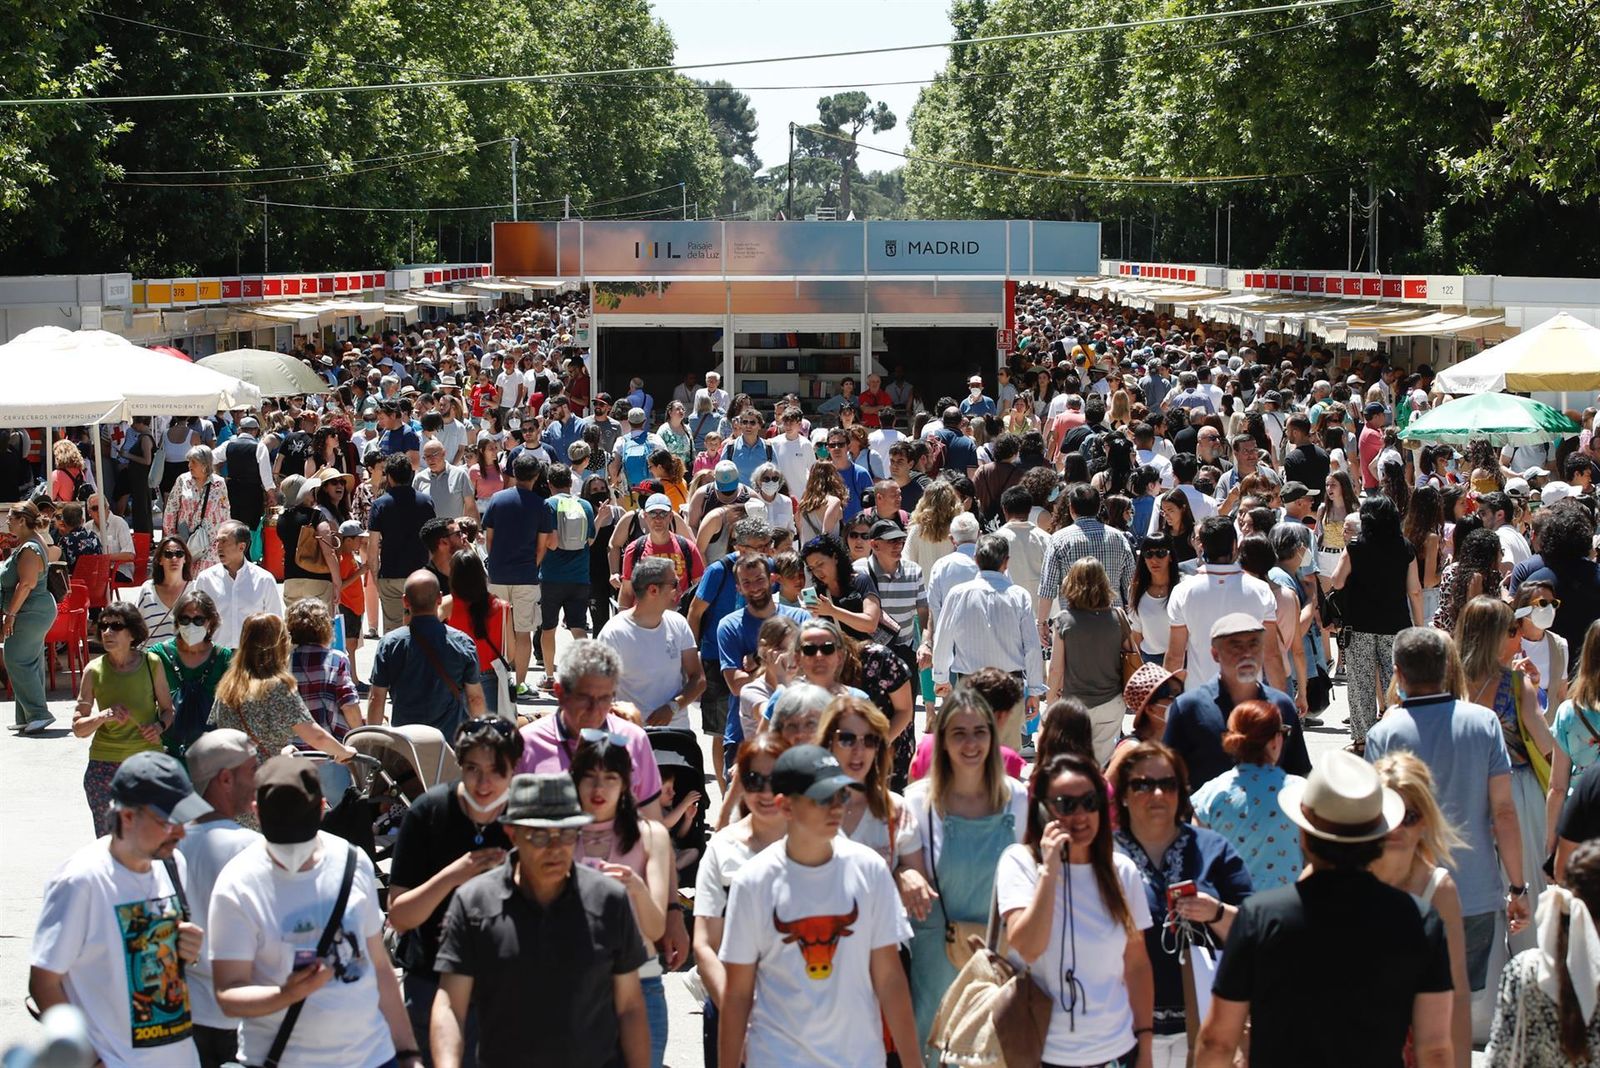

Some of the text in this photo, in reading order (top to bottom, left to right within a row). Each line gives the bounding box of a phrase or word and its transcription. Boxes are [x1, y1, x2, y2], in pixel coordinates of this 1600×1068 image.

[687, 242, 712, 253] Paisaje
[908, 241, 980, 255] MADRID
[687, 251, 697, 259] de
[706, 250, 719, 259] Luz
[222, 285, 230, 293] 76
[243, 284, 251, 293] 75
[1393, 283, 1401, 291] 12
[1416, 285, 1427, 293] 123
[1442, 286, 1453, 294] 122
[173, 288, 185, 297] 378
[135, 1026, 162, 1040] 2001
